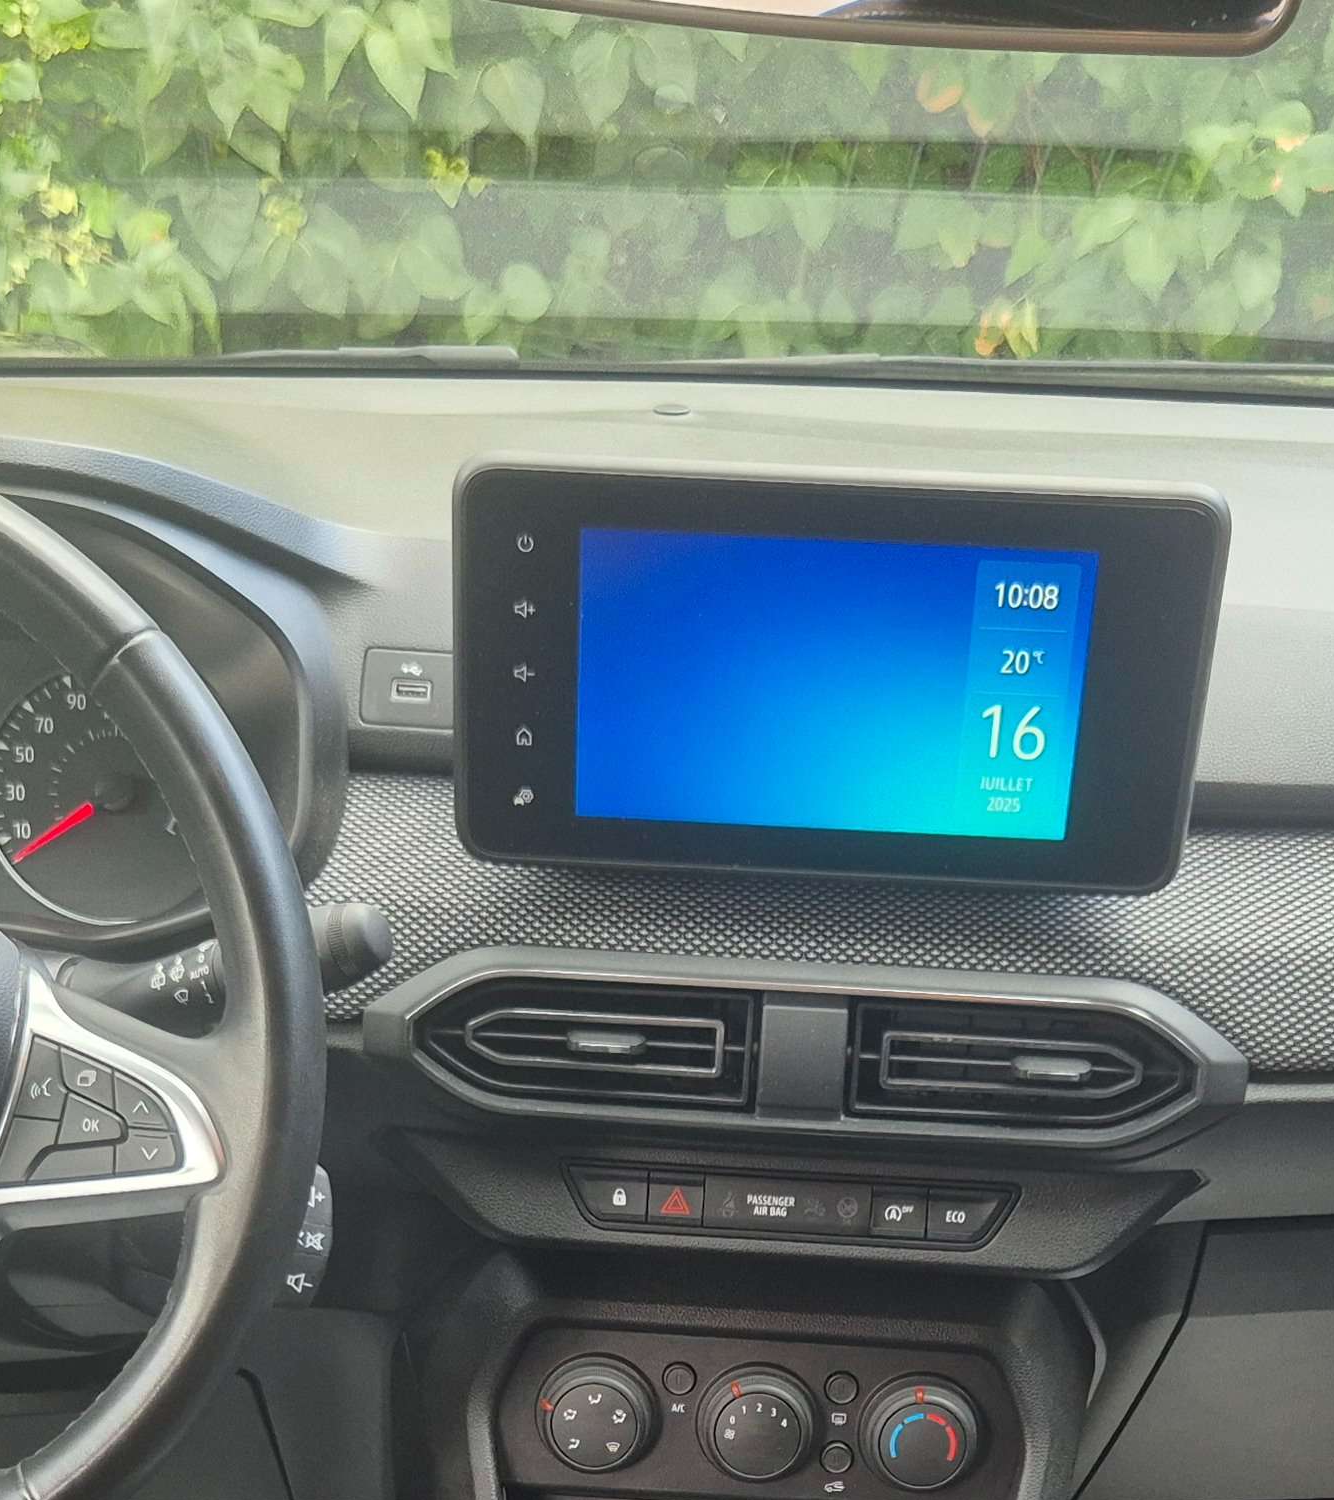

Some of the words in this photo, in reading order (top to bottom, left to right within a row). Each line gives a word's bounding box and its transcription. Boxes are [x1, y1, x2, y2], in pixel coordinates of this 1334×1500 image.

[994, 582, 1060, 610] 10:08
[66, 693, 87, 711] 90
[35, 717, 54, 735] 70
[982, 704, 1046, 760] 16
[15, 746, 35, 764] 50
[980, 776, 1033, 792] JUILLET
[6, 784, 26, 802] 30
[987, 796, 1021, 812] 2025
[13, 822, 31, 840] 10
[189, 965, 210, 980] AUTO
[82, 1117, 100, 1134] OK
[747, 1194, 795, 1207] PASSENGER
[753, 1206, 769, 1217] AIR
[770, 1207, 788, 1218] BAG
[945, 1211, 966, 1224] ECO
[671, 1403, 685, 1413] A/C
